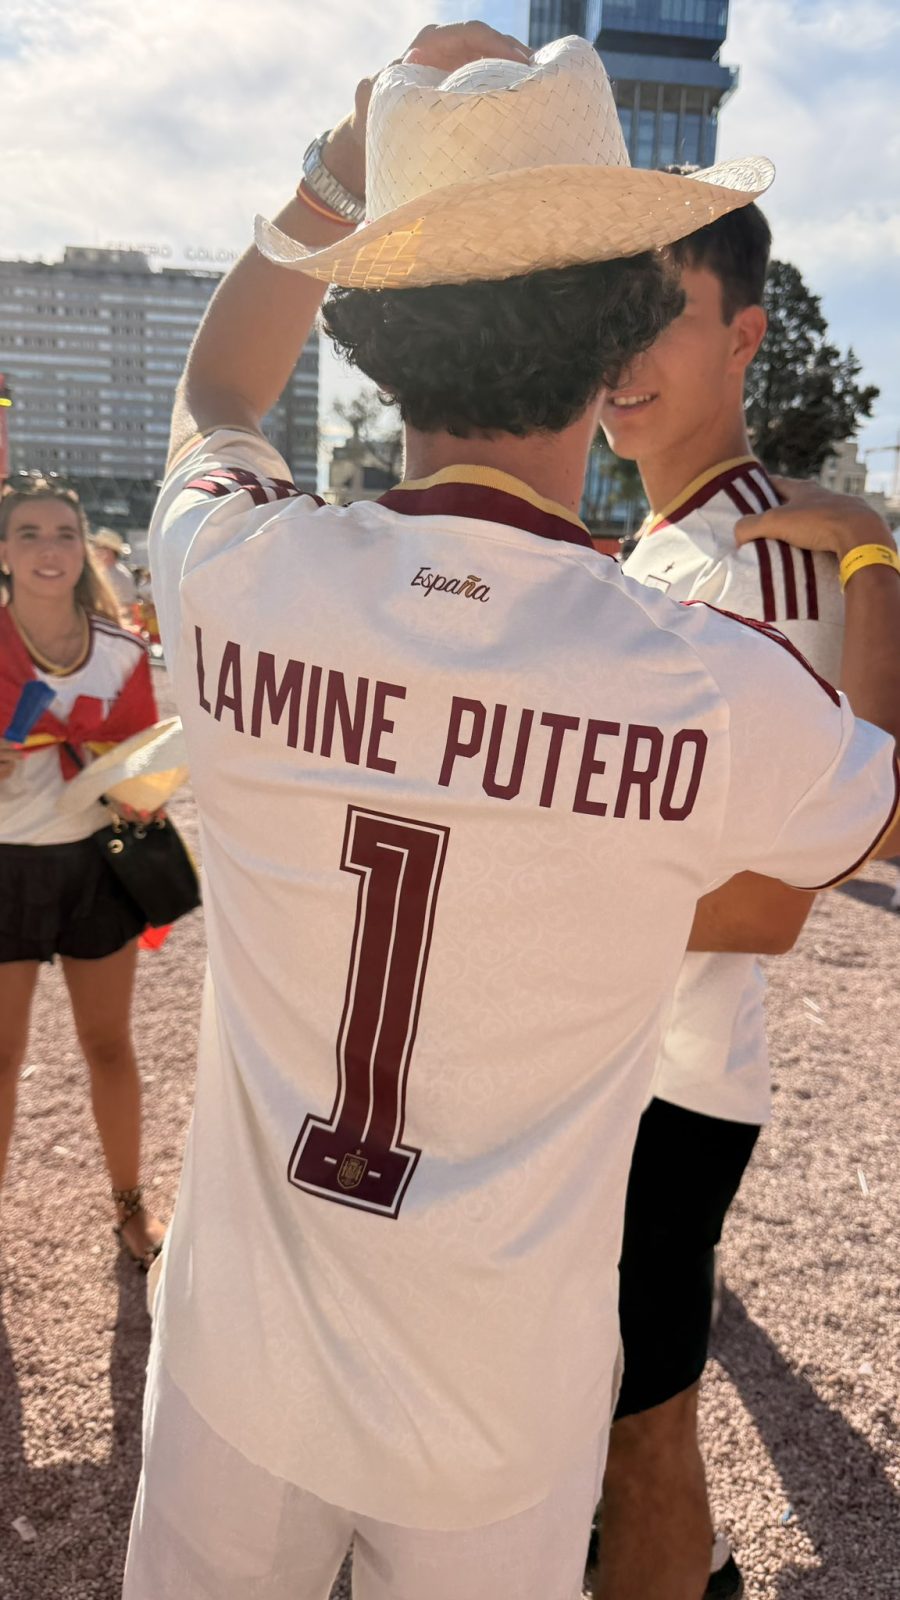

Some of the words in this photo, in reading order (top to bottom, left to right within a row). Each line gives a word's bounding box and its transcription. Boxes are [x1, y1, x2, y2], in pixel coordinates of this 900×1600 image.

[411, 567, 490, 602] España
[195, 625, 407, 774] LAMINE
[438, 696, 708, 821] PUTERO
[287, 804, 451, 1220] 1
